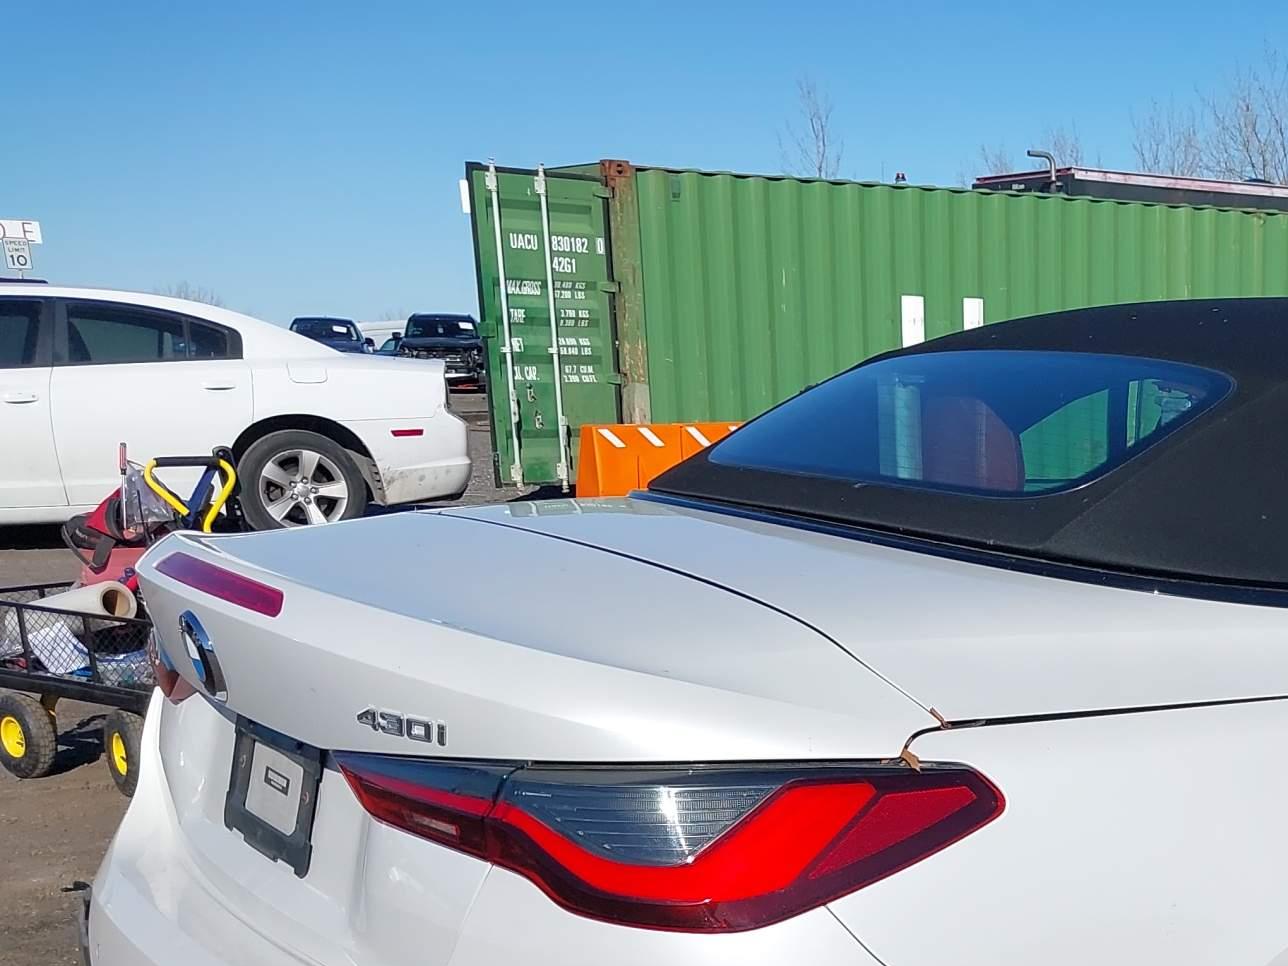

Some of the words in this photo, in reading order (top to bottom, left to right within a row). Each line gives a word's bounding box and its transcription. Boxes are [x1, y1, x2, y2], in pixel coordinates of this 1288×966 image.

[509, 233, 538, 250] UACU
[552, 235, 589, 253] 830182
[9, 254, 28, 267] 10
[552, 256, 577, 273] 42G1
